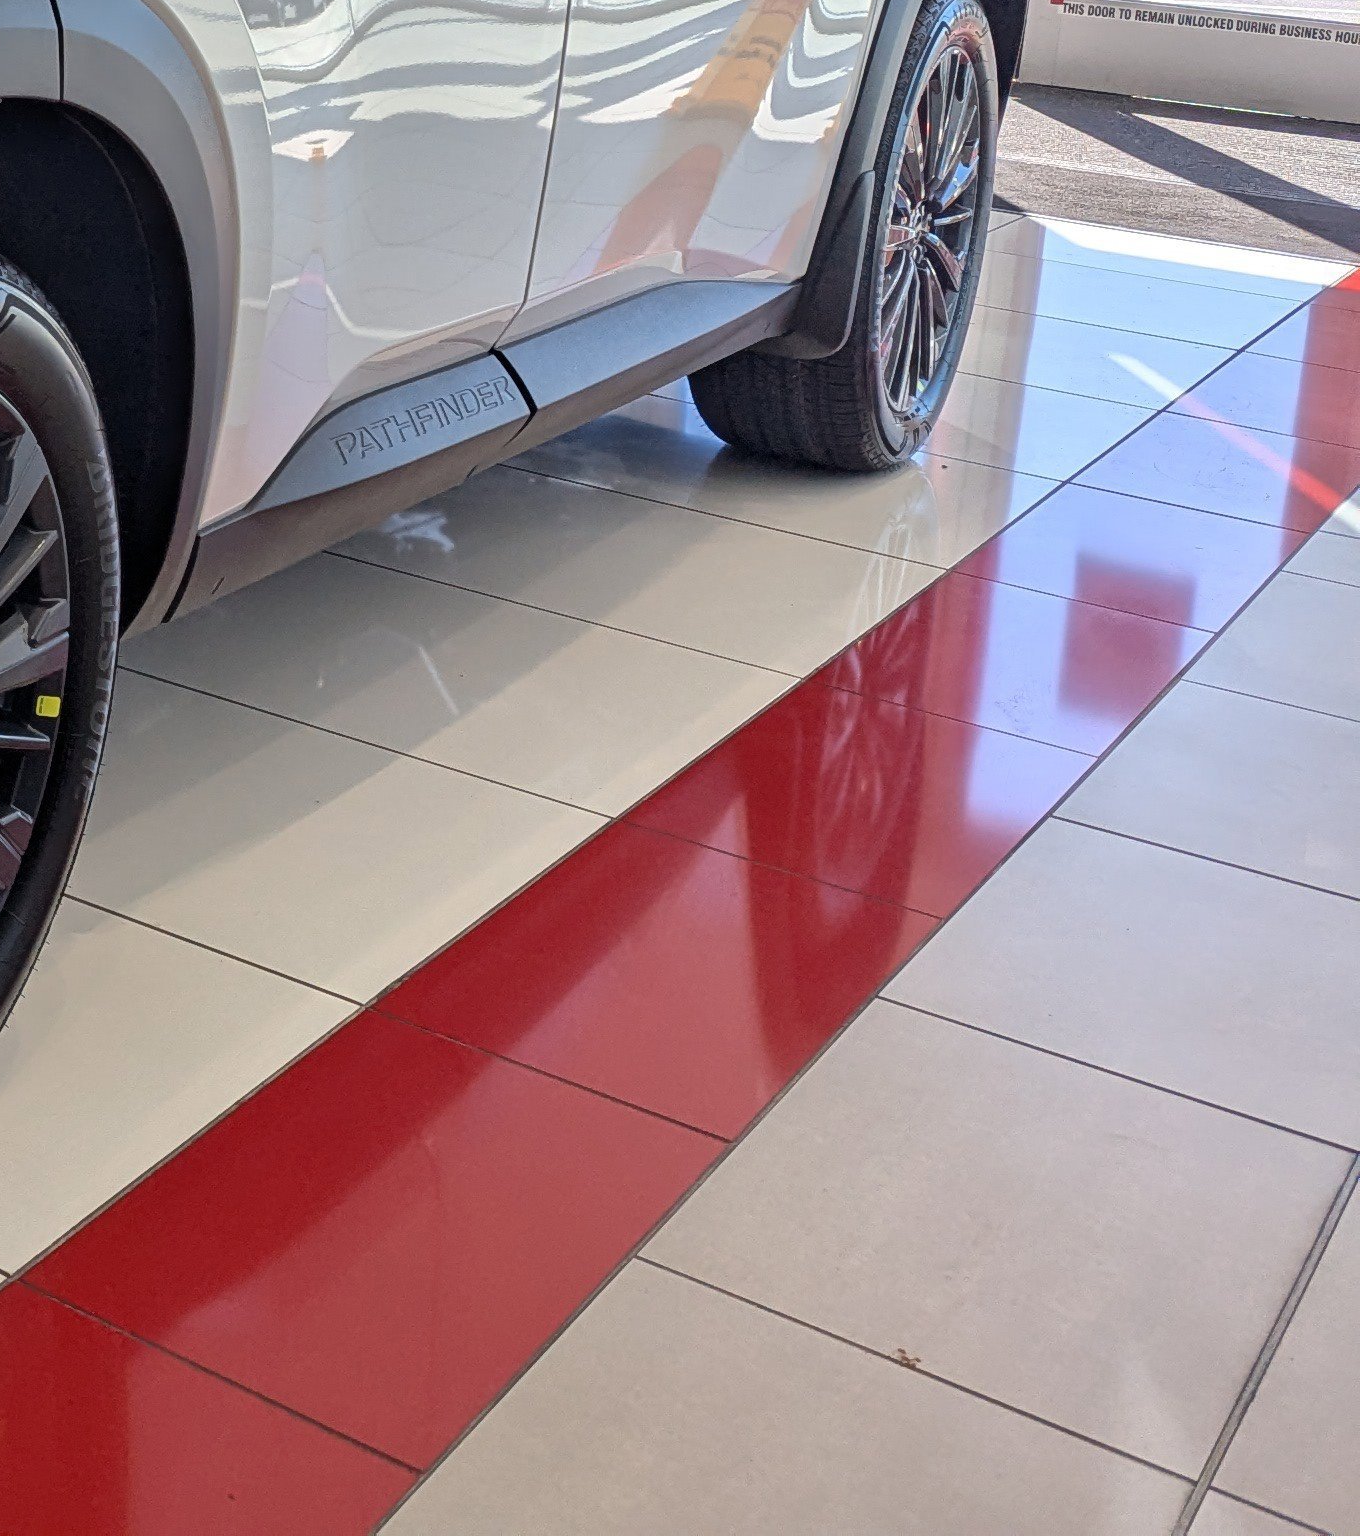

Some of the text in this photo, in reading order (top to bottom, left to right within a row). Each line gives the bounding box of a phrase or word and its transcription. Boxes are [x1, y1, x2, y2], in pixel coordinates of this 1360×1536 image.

[1063, 2, 1085, 15] THIS
[1087, 4, 1116, 18] DOOR
[1119, 7, 1132, 20] TO
[1134, 9, 1175, 25] REMAIN
[1177, 13, 1234, 31] UNLOCKED
[1235, 19, 1276, 35] DURING
[1279, 23, 1332, 41] BUSINESS
[330, 375, 517, 466] PATHFINDER
